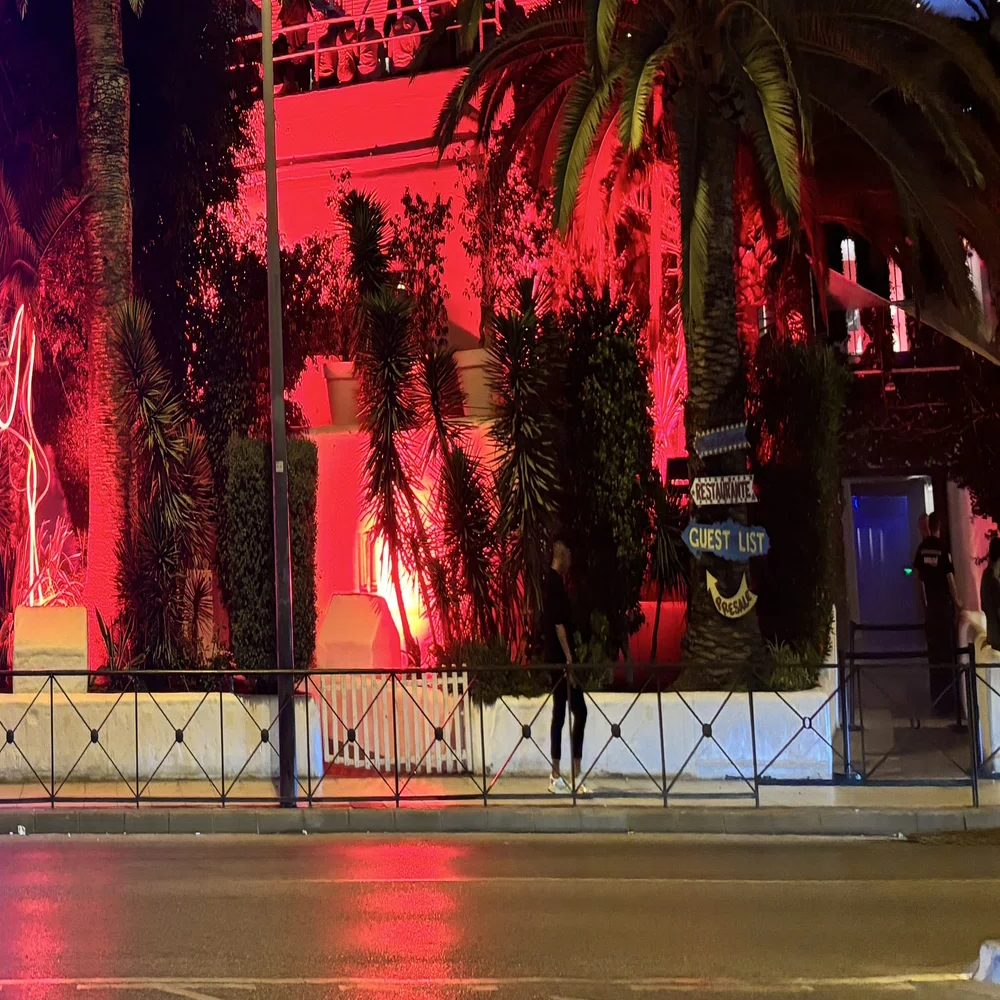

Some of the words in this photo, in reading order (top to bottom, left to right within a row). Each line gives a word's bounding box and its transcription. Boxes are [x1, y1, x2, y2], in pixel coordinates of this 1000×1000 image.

[695, 481, 750, 501] RESTAURANTE
[689, 527, 731, 551] GUEST
[739, 531, 765, 554] LIST
[715, 590, 753, 616] PRESALE
